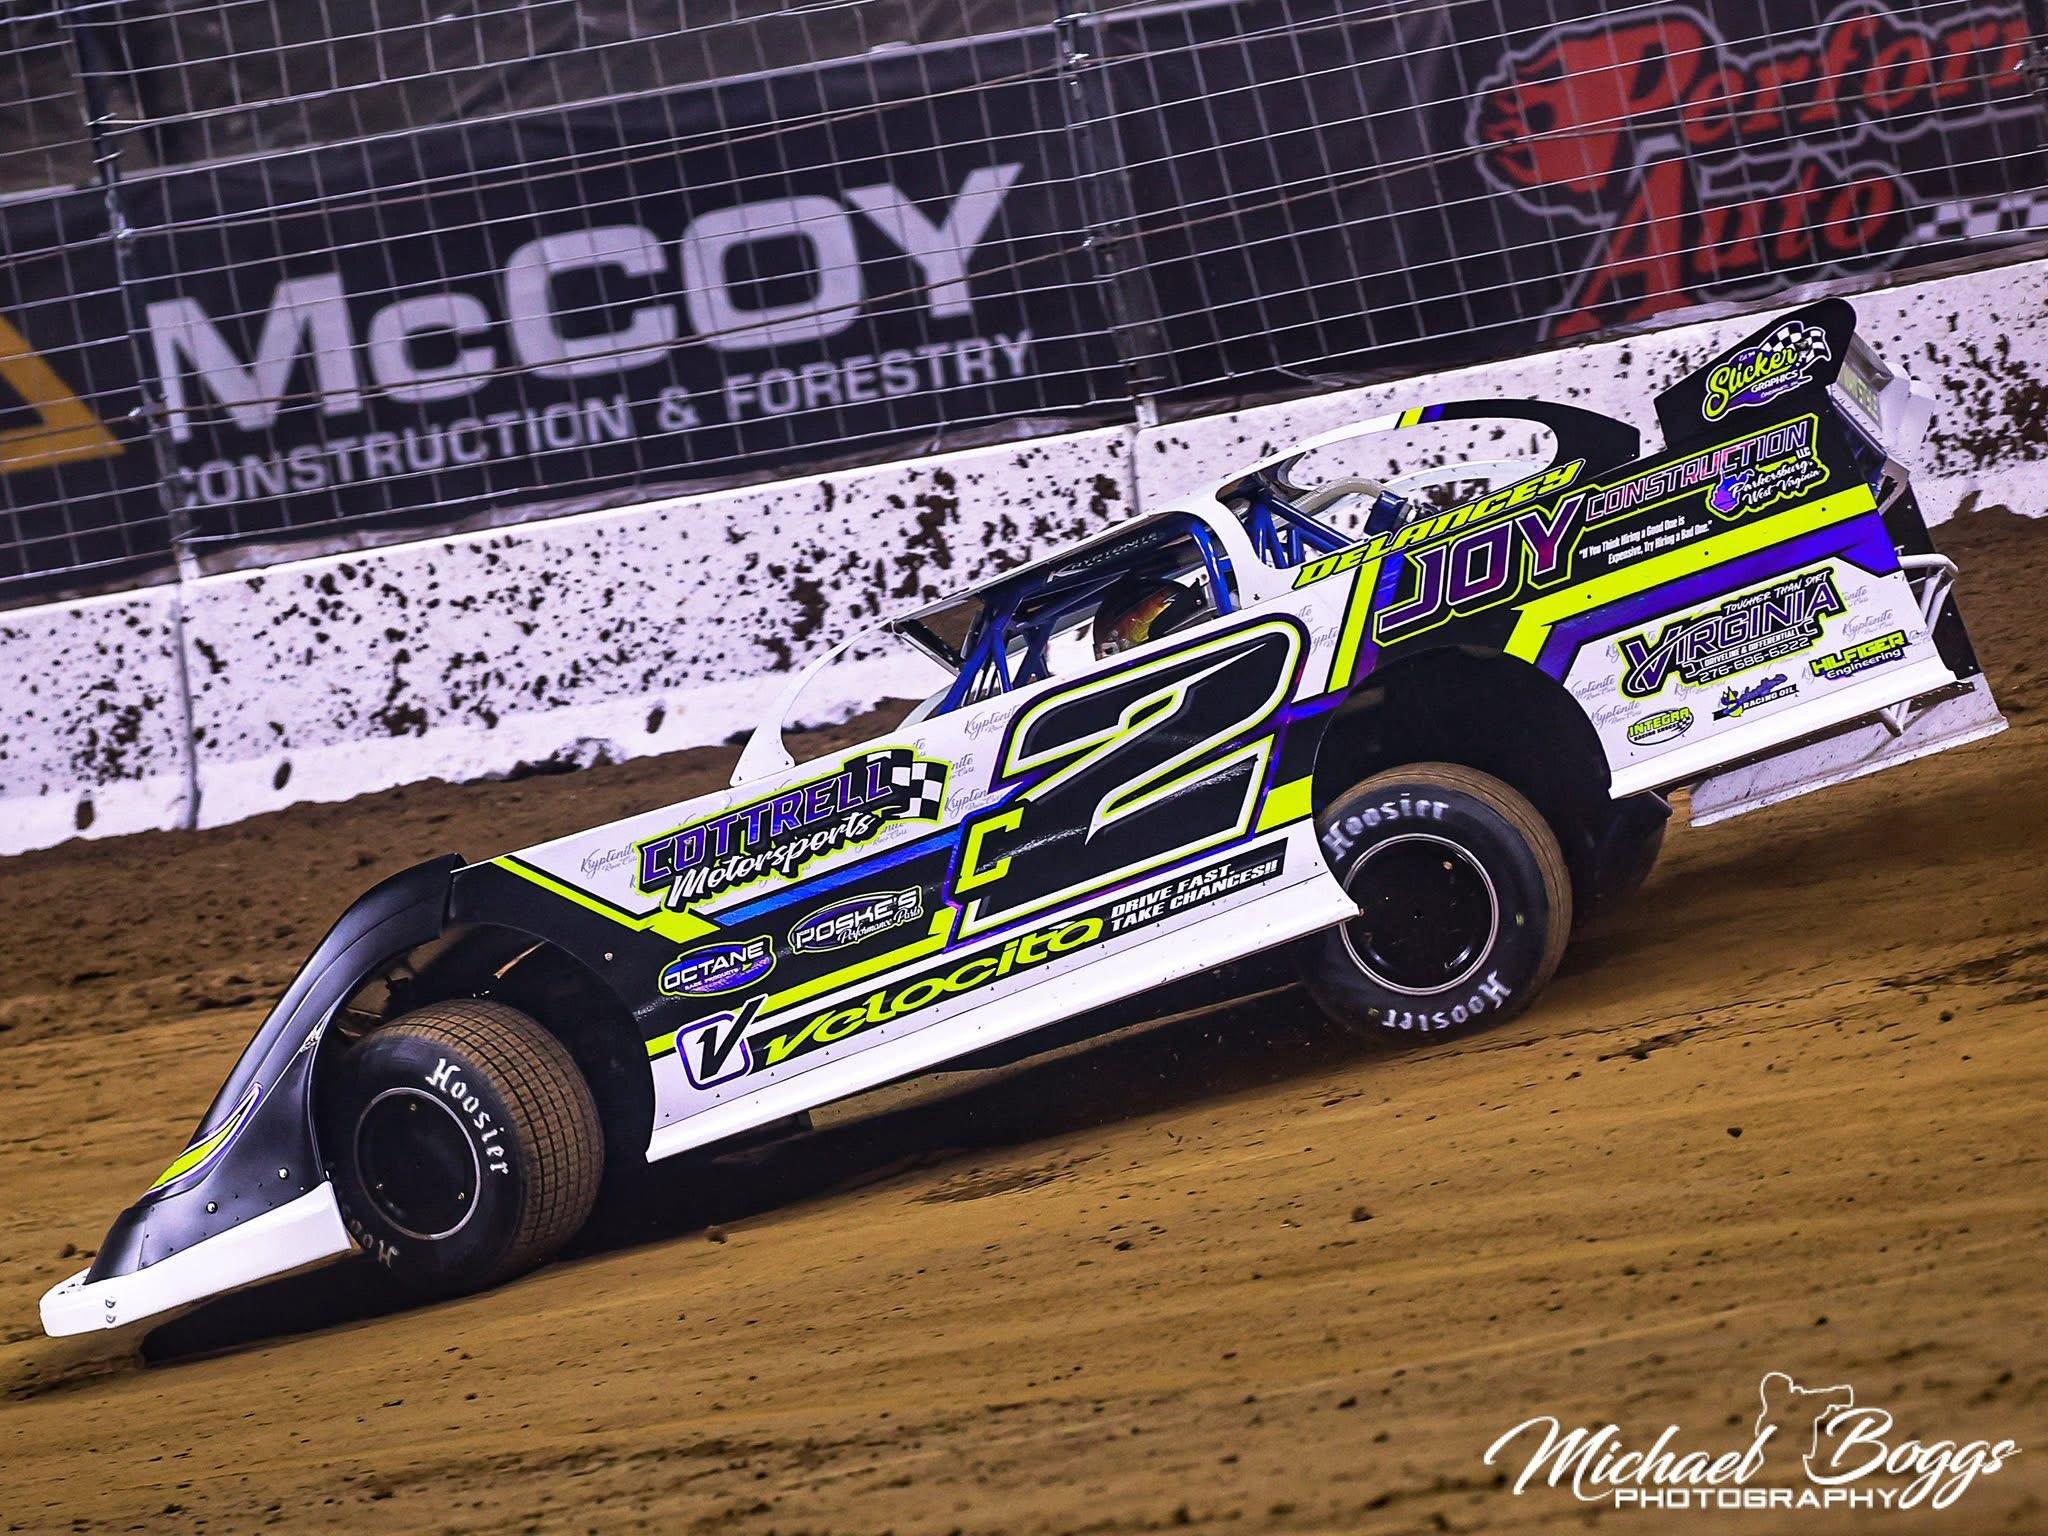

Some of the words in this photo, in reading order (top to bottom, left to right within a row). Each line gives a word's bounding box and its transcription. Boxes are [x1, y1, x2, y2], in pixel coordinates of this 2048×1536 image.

[1555, 158, 1895, 337] Auto
[147, 162, 1023, 440] McCOY
[656, 386, 700, 432] &
[724, 329, 1034, 420] FORESTRY
[1706, 348, 1798, 417] Slicker
[1751, 369, 1799, 393] GRAPHICS
[1585, 421, 1808, 522] CONSTRUCTION
[1796, 446, 1812, 460] LLC
[1293, 460, 1584, 588] DELANCEY
[1621, 529, 1641, 546] Hiring
[1678, 516, 1685, 526] is
[1644, 540, 1654, 553] Try
[1655, 533, 1675, 549] Hiring
[1681, 526, 1694, 540] Bad
[1379, 494, 1584, 633] JOY
[1724, 592, 1771, 615] TOUGHER
[1774, 580, 1802, 598] THAN
[1804, 571, 1830, 587] DIRT
[1626, 582, 1839, 692] VIRGINIA
[1699, 638, 1810, 681] 276-686-6222
[1811, 632, 1905, 675] HILFIGER
[1827, 648, 1902, 679] Engineering
[965, 704, 1019, 740] Kryptonit
[1628, 707, 1690, 737] INTEGRA
[1743, 692, 1777, 709] RACING
[1779, 687, 1795, 697] OIL
[642, 762, 892, 884] COTTRELL
[1322, 793, 1449, 863] Hoosier
[667, 812, 876, 907] Motorsports
[1111, 885, 1172, 918] DRIVE
[1177, 863, 1235, 894] FAST.
[1111, 902, 1164, 932] TAKE
[1170, 860, 1278, 910] CHANCES!!
[796, 891, 917, 949] POSKE'S
[837, 919, 893, 943] Performance
[894, 907, 920, 923] Parts
[664, 941, 764, 989] OCTANE
[1382, 970, 1512, 1031] Hoosier
[425, 1058, 509, 1175] Hoosier
